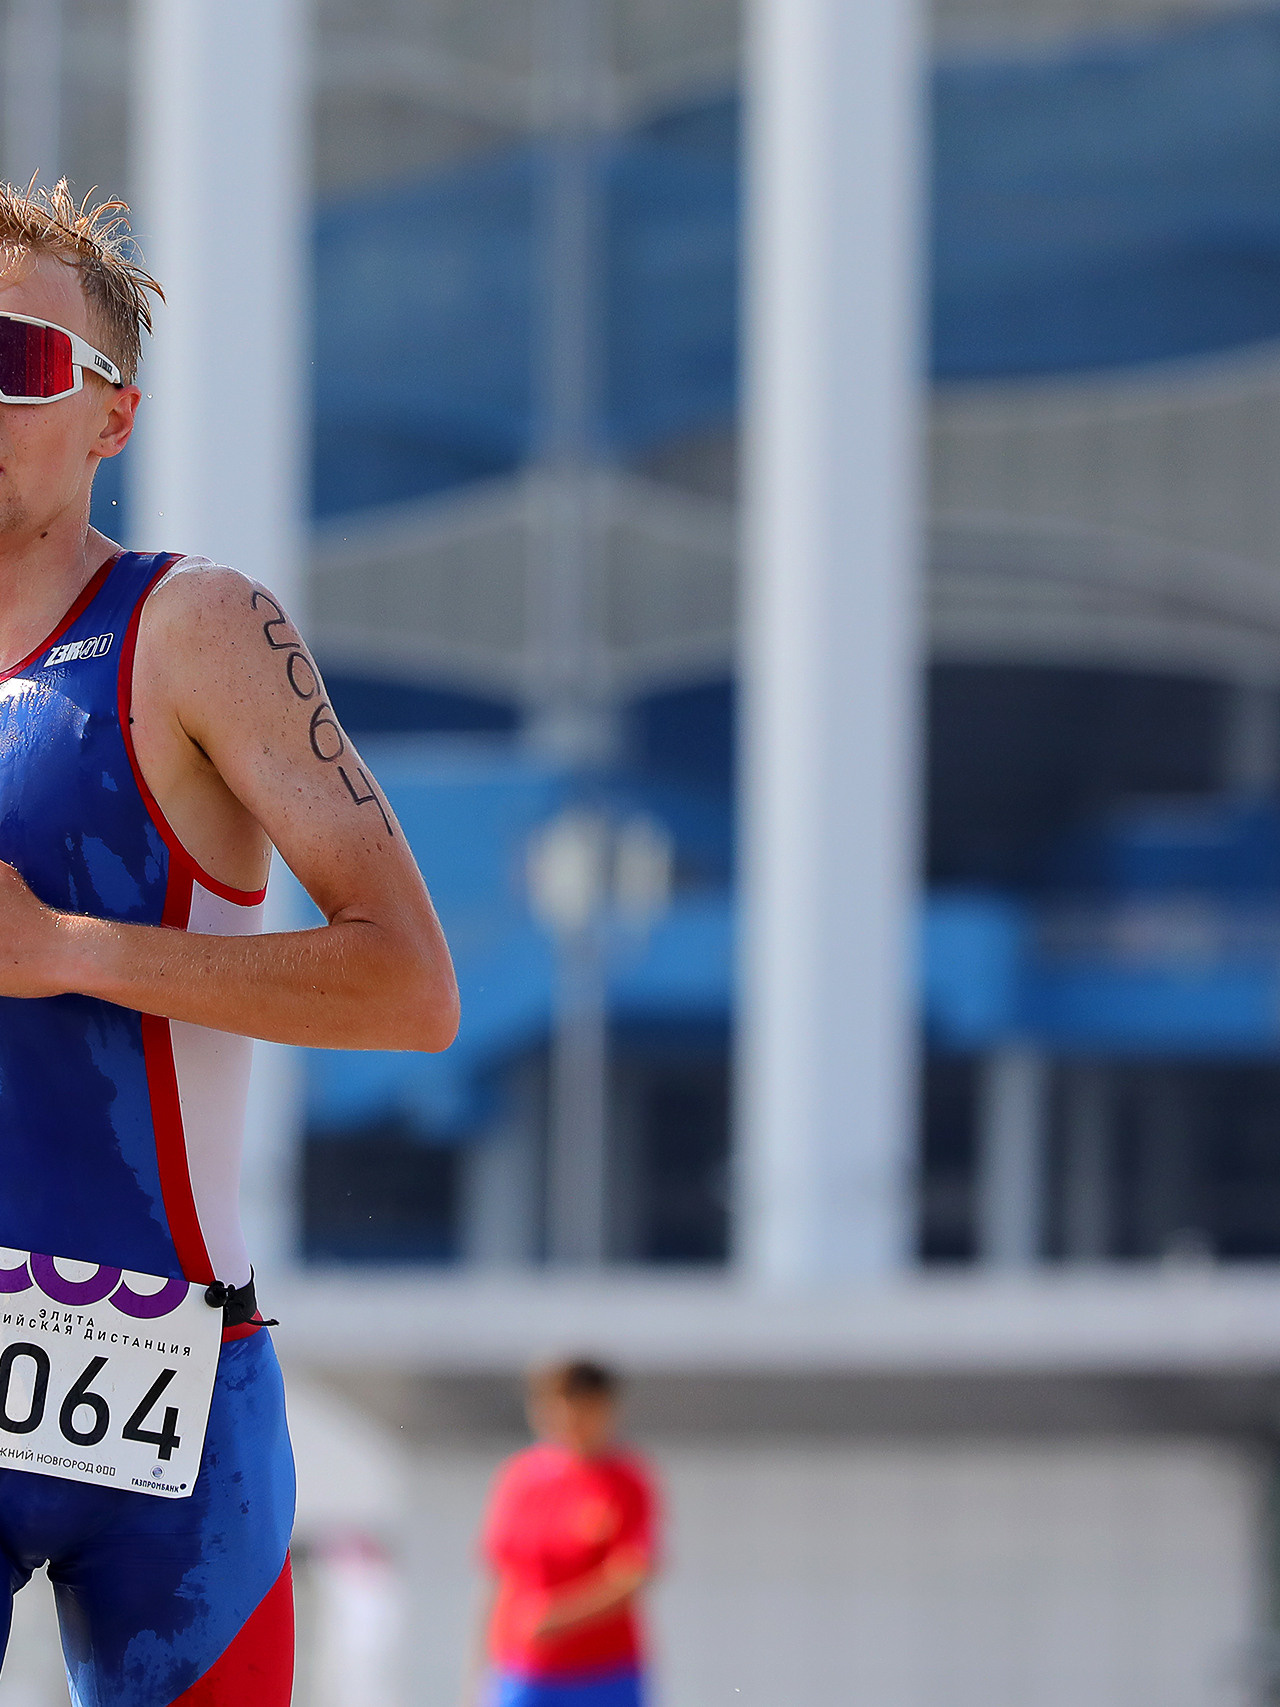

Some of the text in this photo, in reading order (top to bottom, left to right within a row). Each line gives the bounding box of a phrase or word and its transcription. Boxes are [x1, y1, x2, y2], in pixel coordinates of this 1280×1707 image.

[251, 590, 393, 836] 2064
[39, 1308, 95, 1327] ЭЛИТА
[83, 1328, 191, 1356] ДИСТАНЦИЯ
[37, 1453, 94, 1474] НОВГОРОД
[131, 1477, 180, 1493] ГАЗПРОМБАНК
